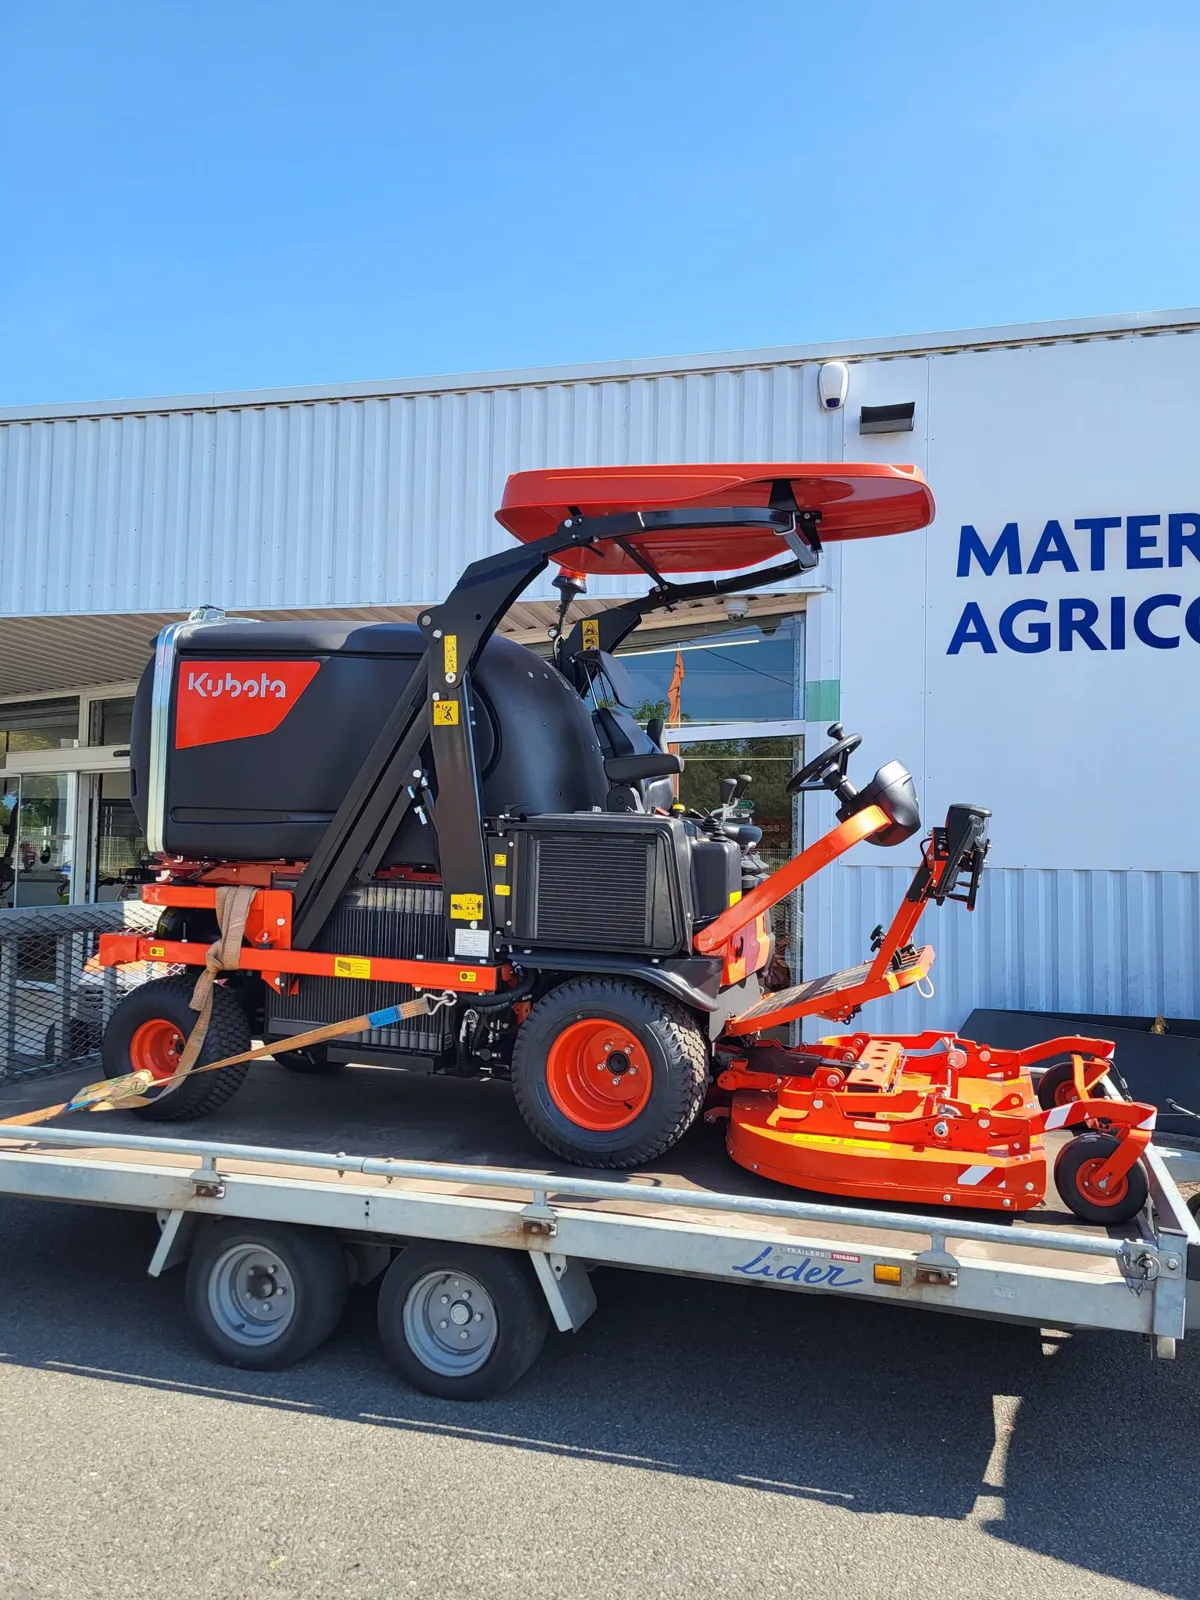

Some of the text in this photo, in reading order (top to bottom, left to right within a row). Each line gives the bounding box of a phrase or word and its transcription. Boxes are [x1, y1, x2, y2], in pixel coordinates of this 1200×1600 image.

[956, 512, 1200, 577] MATER
[946, 593, 1200, 655] AGRIC
[188, 672, 286, 698] Kubota
[731, 1245, 864, 1287] Lider
[786, 1247, 860, 1262] TRAILERS TRIGANO
